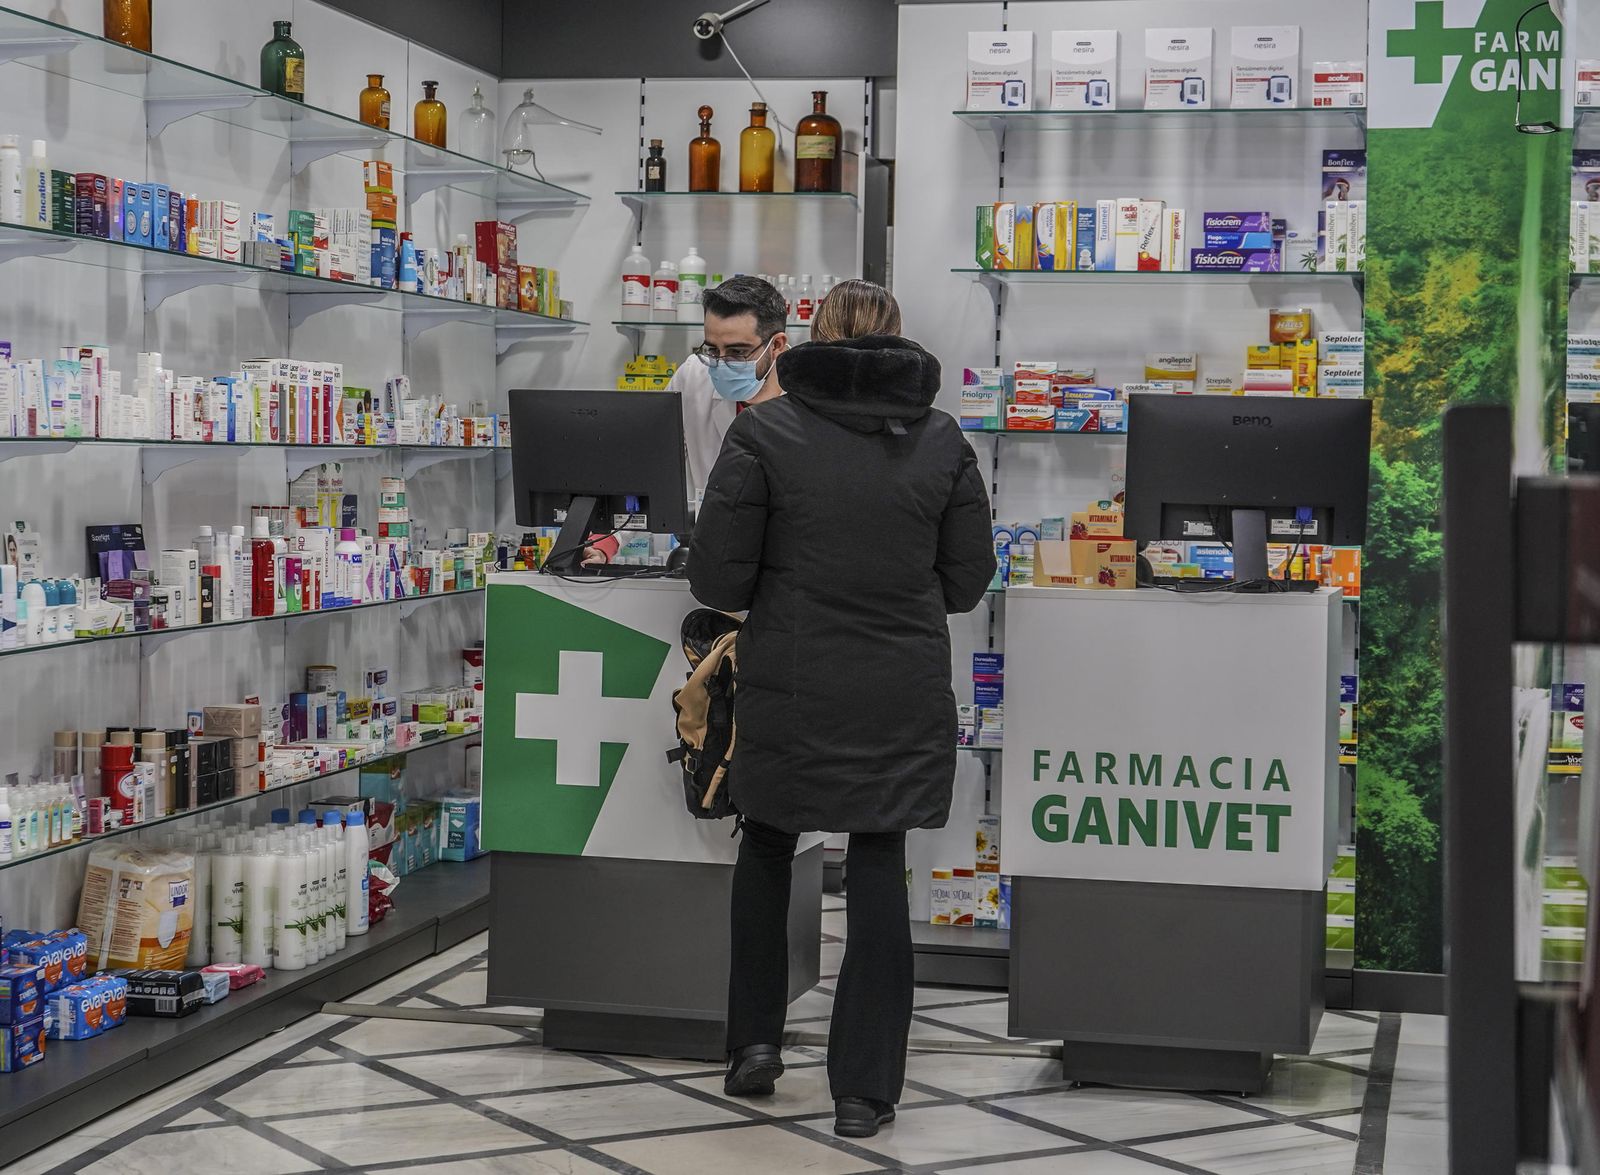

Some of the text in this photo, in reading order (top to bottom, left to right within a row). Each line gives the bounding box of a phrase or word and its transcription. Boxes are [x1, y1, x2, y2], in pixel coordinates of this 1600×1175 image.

[1328, 159, 1355, 167] Bonflex
[39, 172, 47, 223] Zincation
[1122, 204, 1138, 212] radio
[1206, 217, 1242, 227] fisiocrem
[1140, 226, 1156, 251] Reflex
[1194, 254, 1244, 265] fisiocrem
[1325, 335, 1363, 344] Septolete
[1158, 356, 1193, 364] angileptol
[1324, 370, 1362, 378] Septolete
[1206, 378, 1233, 386] Strepsils
[962, 390, 994, 400] Friolgrip
[1232, 415, 1273, 428] BenQ
[1088, 514, 1118, 523] VITAMINA C
[1110, 554, 1136, 563] VITAMINA C
[1050, 576, 1078, 584] VITAMINA C
[1033, 750, 1290, 792] FARMACIA
[1032, 794, 1292, 852] GANIVET
[63, 940, 88, 960] evax
[39, 948, 63, 968] evax
[102, 984, 128, 1004] evax
[81, 990, 103, 1013] evax
